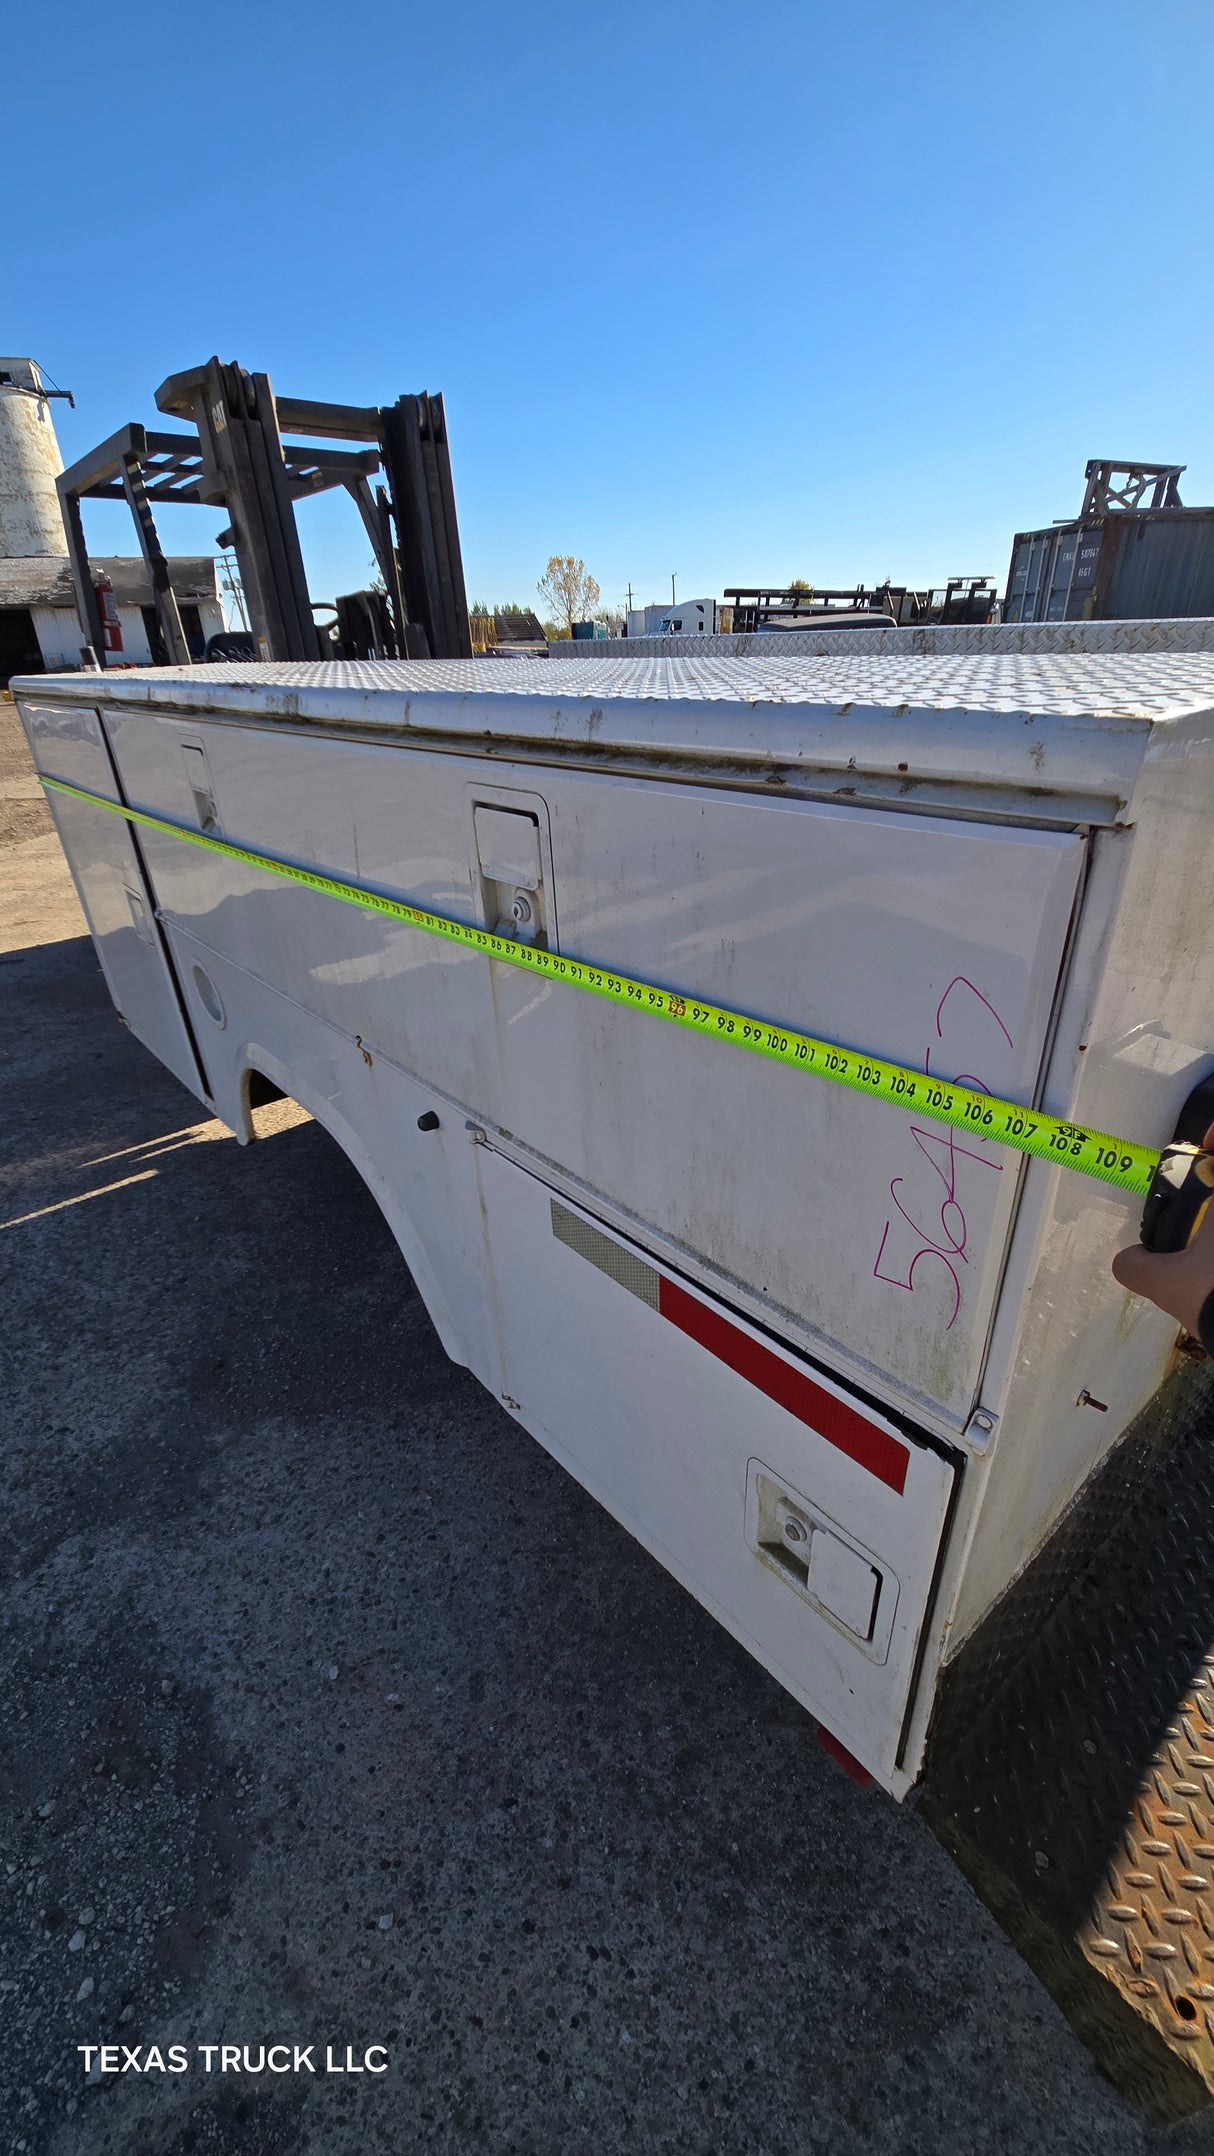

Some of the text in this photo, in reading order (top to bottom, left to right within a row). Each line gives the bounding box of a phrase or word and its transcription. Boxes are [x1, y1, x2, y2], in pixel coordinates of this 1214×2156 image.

[438, 920, 448, 932] 82
[450, 924, 460, 936] 83
[476, 933, 487, 945] 85
[491, 938, 502, 950] 86
[505, 943, 516, 955] 87
[521, 949, 532, 961] 88
[537, 954, 548, 966] 89
[553, 960, 566, 973] 90
[571, 966, 582, 979] 91
[589, 972, 602, 986] 92
[607, 979, 621, 993] 93
[627, 985, 642, 1000] 94
[648, 993, 663, 1008] 95
[671, 1002, 684, 1014] 96
[692, 1008, 710, 1023] 97
[717, 1016, 735, 1033] 98
[743, 1025, 762, 1041] 99
[767, 1034, 788, 1052] 100
[794, 1043, 815, 1062] 101
[824, 1053, 848, 1074] 102
[856, 1064, 881, 1085] 103
[890, 1076, 916, 1098] 104
[925, 1088, 954, 1111] 105
[964, 1102, 993, 1125] 106
[1005, 1115, 1039, 1139] 107
[1049, 1134, 1082, 1155] 108
[1095, 1147, 1133, 1173] 109
[971, 1095, 983, 1104] 10
[1014, 1109, 1024, 1117] 11
[1063, 1127, 1081, 1139] 9F
